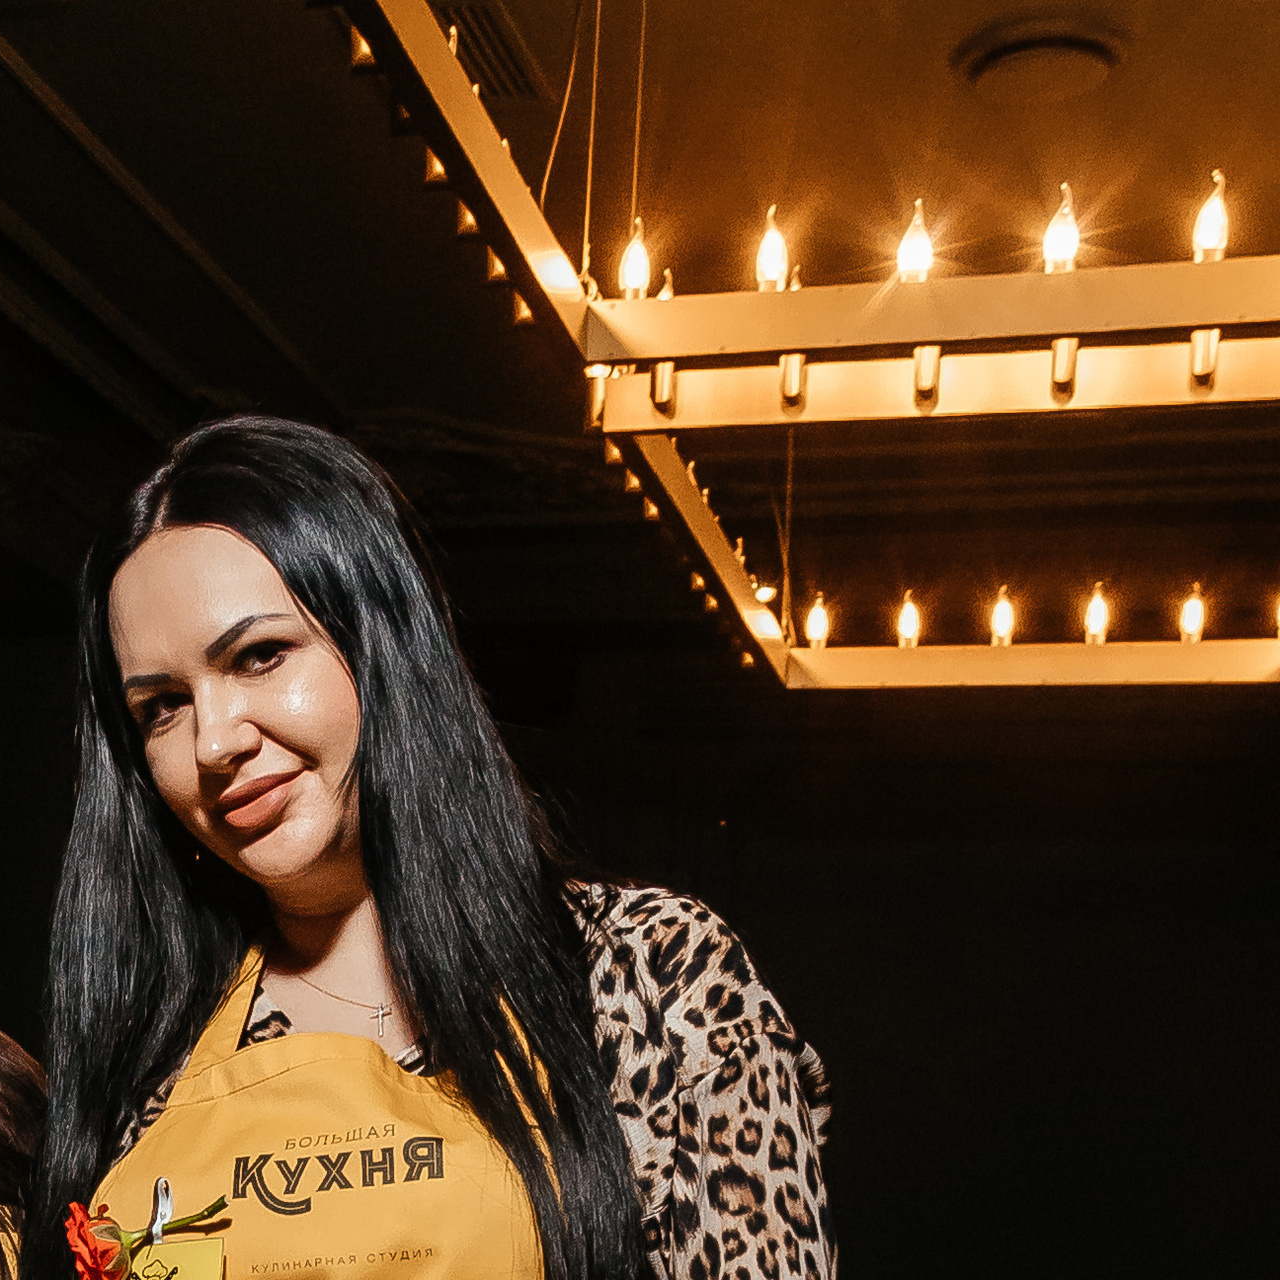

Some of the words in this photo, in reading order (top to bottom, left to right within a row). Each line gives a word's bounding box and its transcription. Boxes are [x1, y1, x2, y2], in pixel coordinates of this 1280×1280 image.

[284, 1123, 397, 1150] БОЛЬШАЯ
[231, 1136, 445, 1217] КУХНЯ
[251, 1255, 357, 1274] КУЛИНАРНАЯ
[366, 1248, 434, 1263] СТУДИЯ
